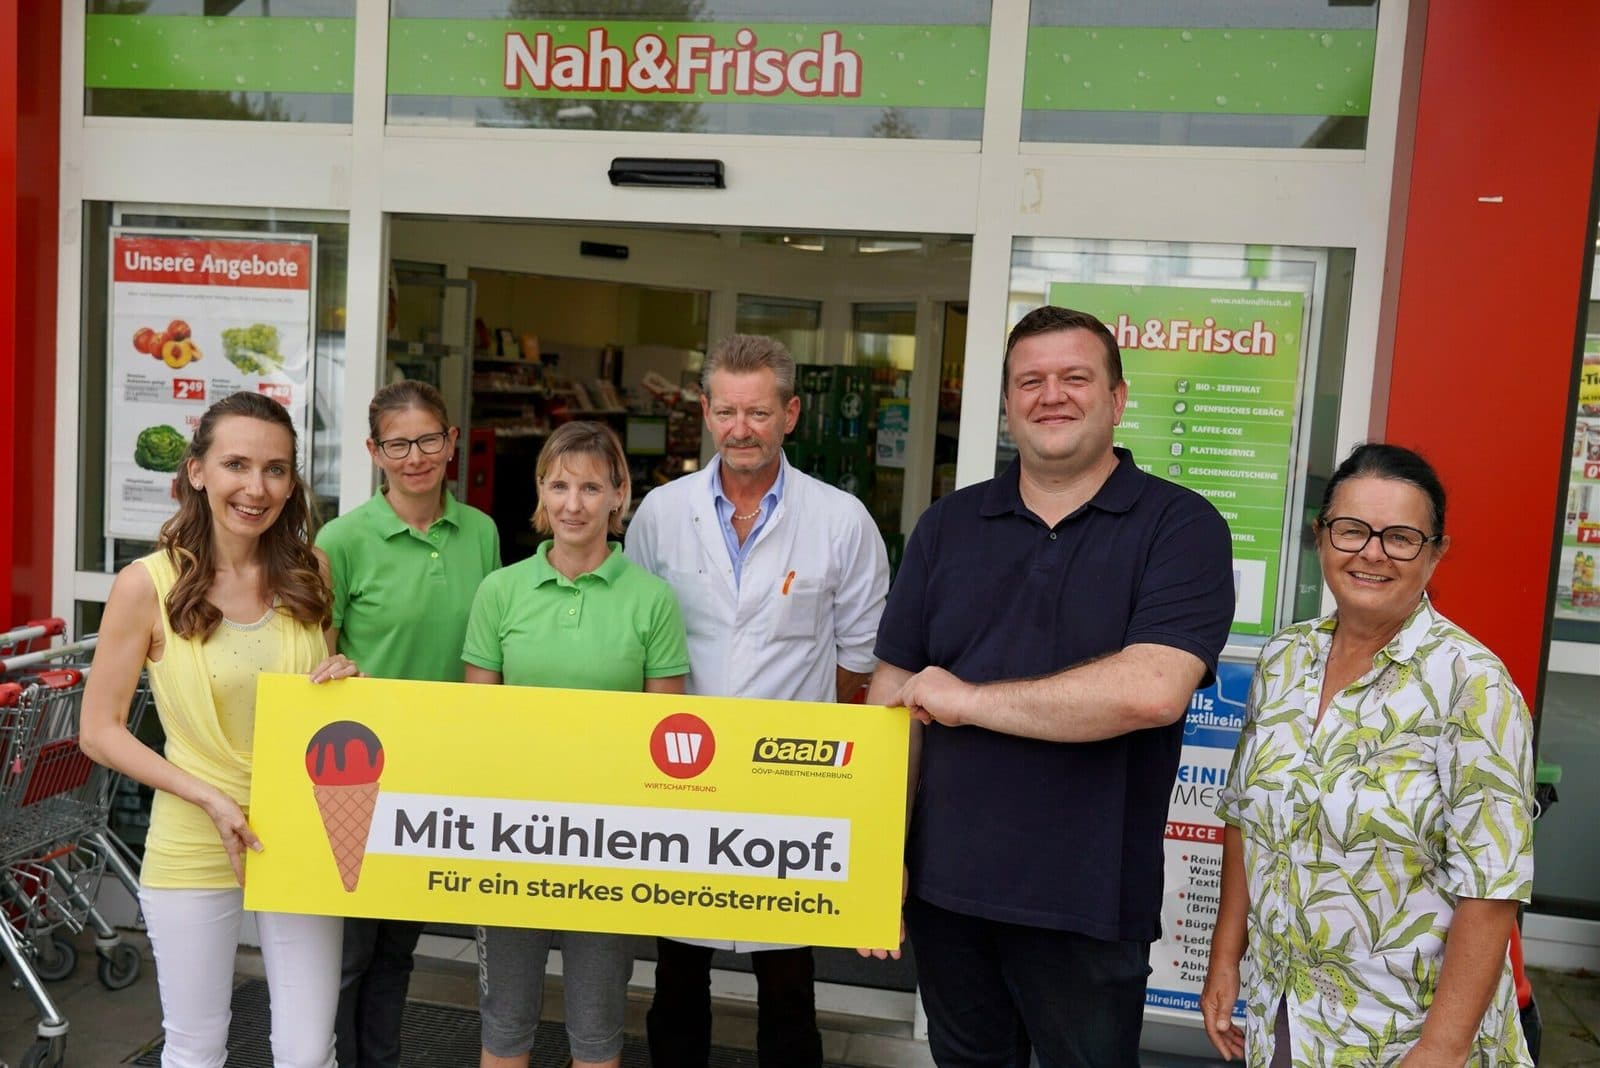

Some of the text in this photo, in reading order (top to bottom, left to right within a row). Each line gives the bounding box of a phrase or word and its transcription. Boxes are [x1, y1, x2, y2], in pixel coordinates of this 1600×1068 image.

[504, 28, 862, 98] Nah&Frisch
[124, 250, 298, 280] Unsere Angebote
[1195, 383, 1210, 391] BIO
[1216, 384, 1261, 393] ZERTIFIKAT
[1194, 404, 1285, 417] OFENFRISCHES GEBÄCK
[1192, 425, 1243, 435] KAFFEE-ECKE
[1190, 446, 1256, 457] PLATTENSERVICE
[1188, 467, 1279, 480] GESCHENKGUTSCHEINE
[758, 736, 833, 763] öaab
[644, 782, 717, 793] WIRTSCHAFTSBUND
[394, 807, 842, 880] Mit kühlem Kopf.
[427, 870, 841, 916] Für ein starkes Oberösterreich.
[1181, 961, 1208, 972] Abh
[1145, 993, 1200, 1009] tilreinigu
